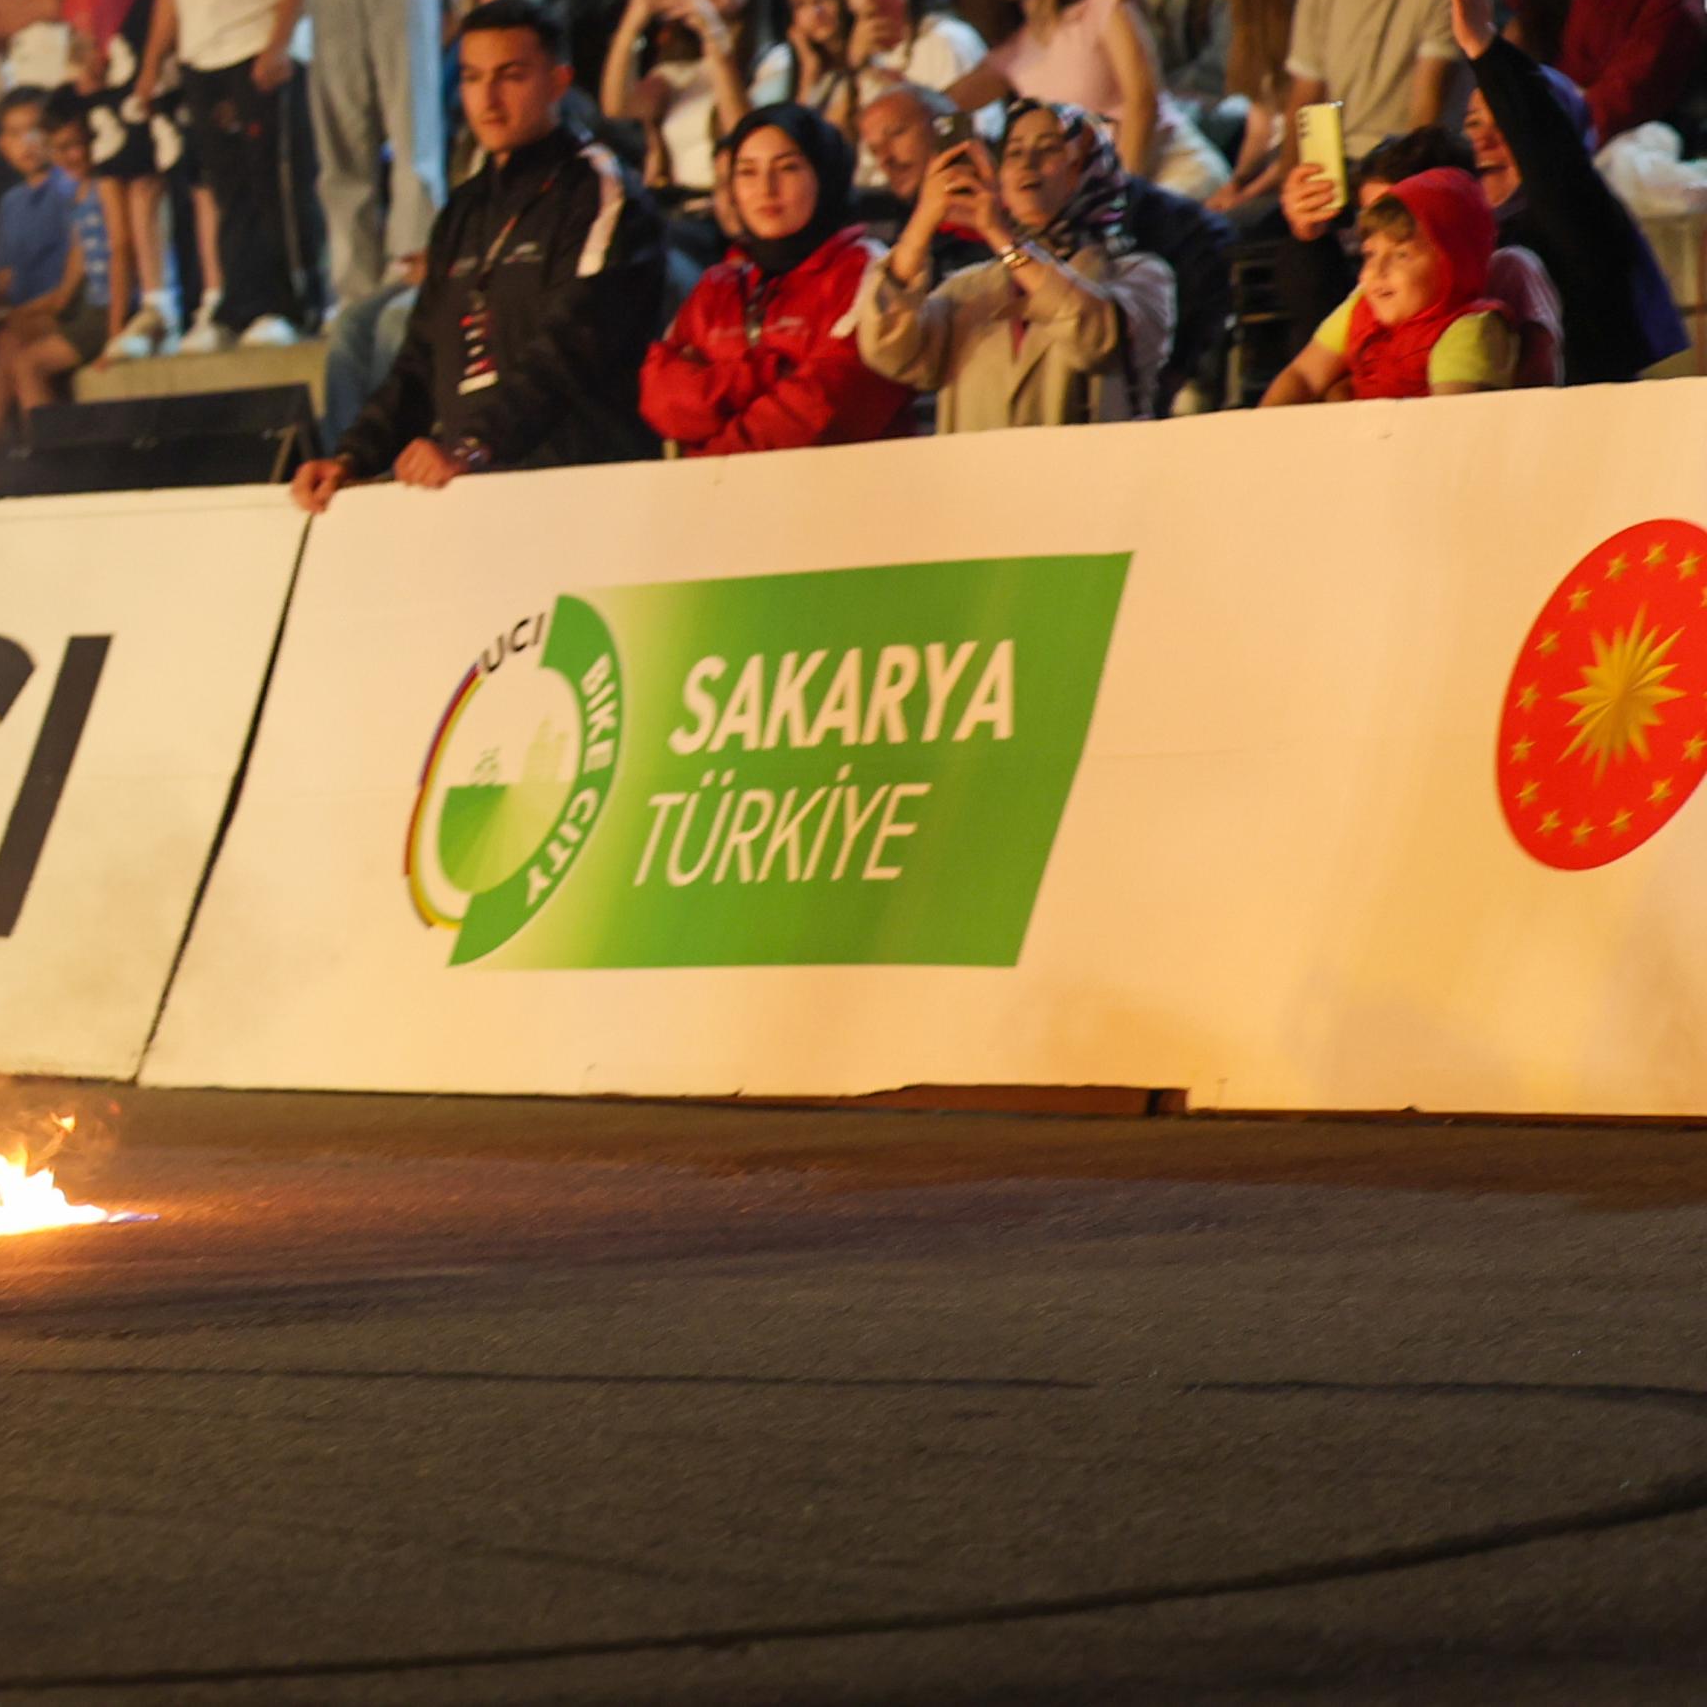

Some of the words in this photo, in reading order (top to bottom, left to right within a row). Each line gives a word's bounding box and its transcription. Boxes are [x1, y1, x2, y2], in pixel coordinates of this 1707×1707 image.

[481, 612, 546, 674] UCI
[668, 639, 1016, 755] SAKARYA
[580, 652, 618, 771] BIKE
[525, 787, 599, 907] CITY
[632, 762, 933, 888] TÜRKİYE
